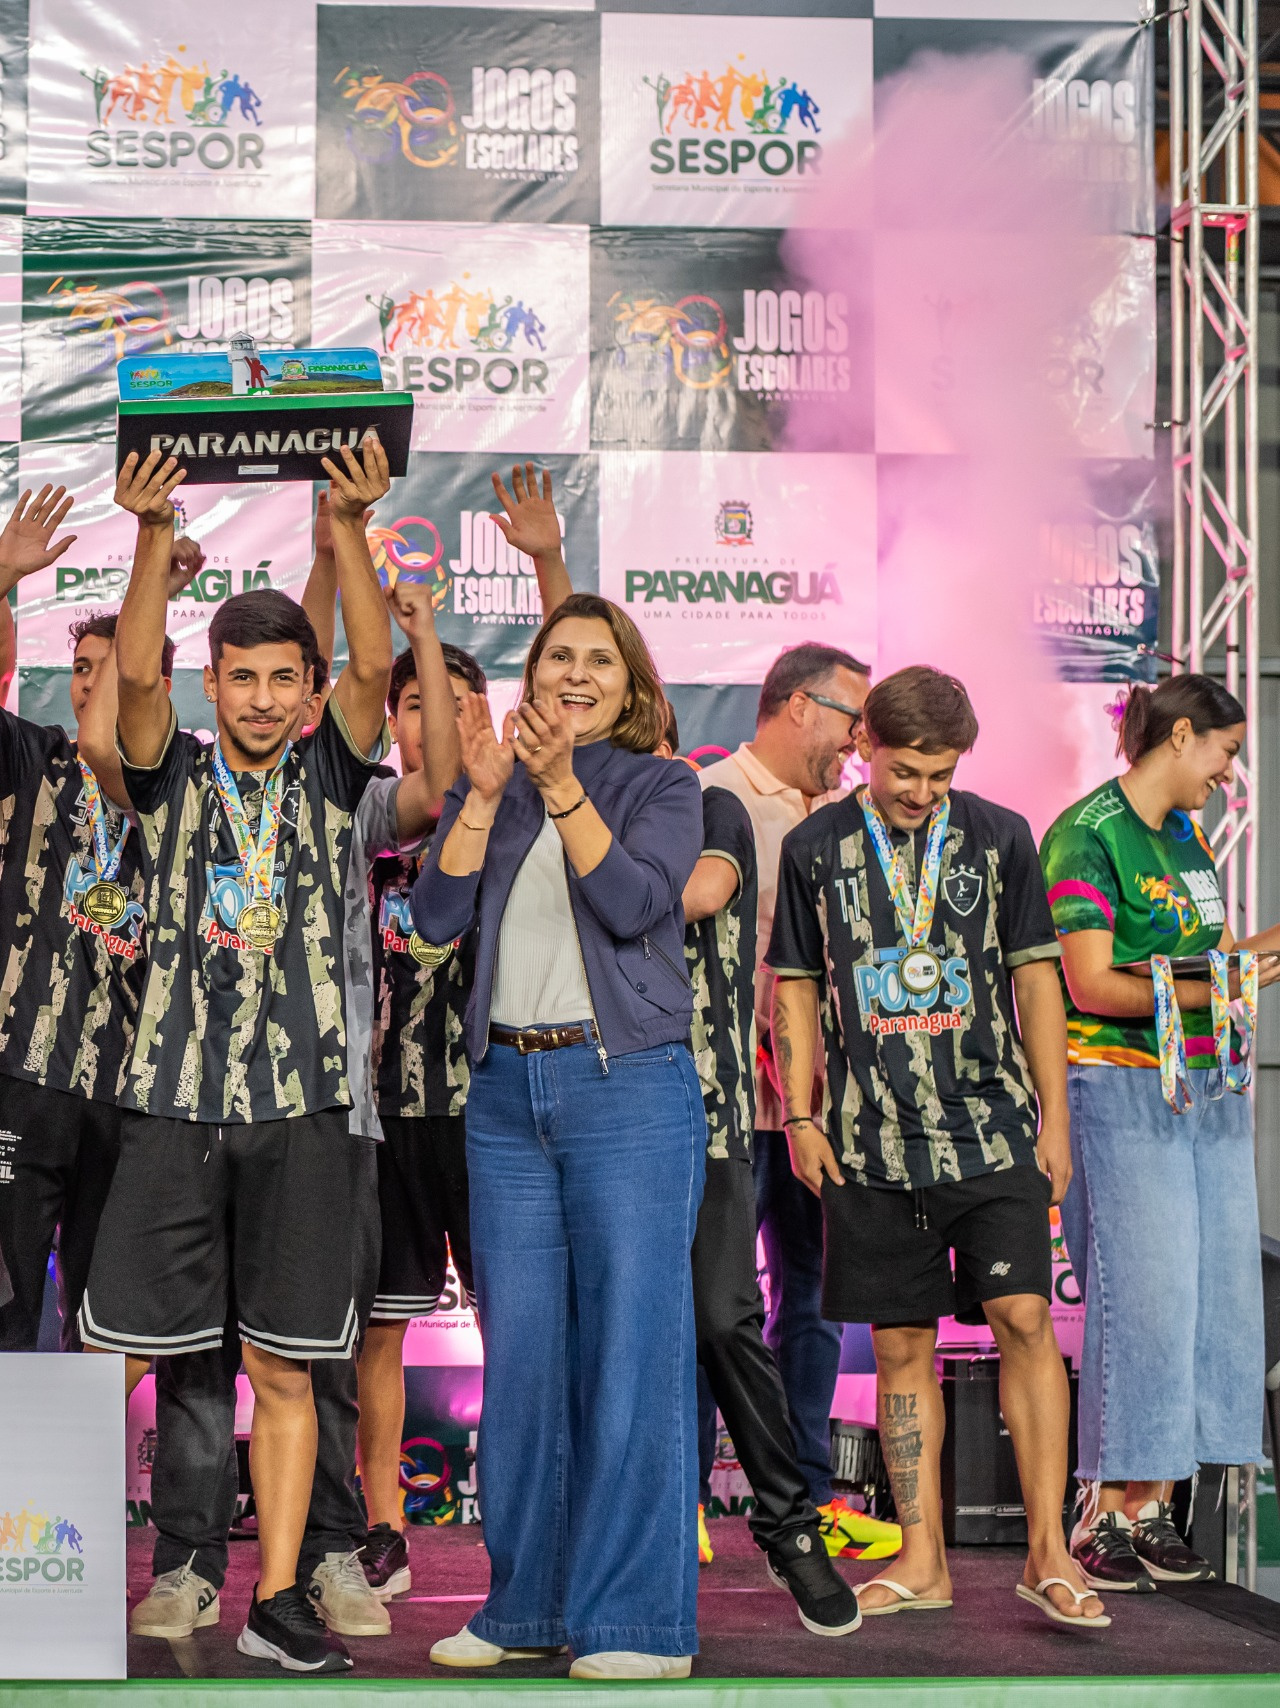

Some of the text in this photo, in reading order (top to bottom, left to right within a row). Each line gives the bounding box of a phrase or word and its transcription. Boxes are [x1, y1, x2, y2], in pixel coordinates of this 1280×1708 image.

[461, 66, 577, 131] JOGOS
[86, 130, 264, 169] SESPOR
[466, 132, 578, 171] ESCOLARES
[650, 138, 823, 176] SESPOR
[176, 275, 294, 339] JOGOS
[733, 289, 849, 353] JOGOS
[129, 380, 173, 389] SESPOR
[308, 362, 368, 373] PARANAGUÁ
[738, 353, 850, 392] ESCOLARES
[213, 556, 230, 564] DE
[675, 557, 770, 565] PREFEITURA
[454, 576, 543, 615] ESCOLAR
[625, 562, 844, 605] PARANAGUÁ
[173, 609, 206, 618] PARA
[473, 616, 544, 625] PARANAGU
[644, 610, 827, 620] UMA CIDADE PARA TODOS
[834, 877, 861, 923] 11
[869, 1007, 962, 1036] Paranaguá
[420, 1320, 458, 1330] Municipal
